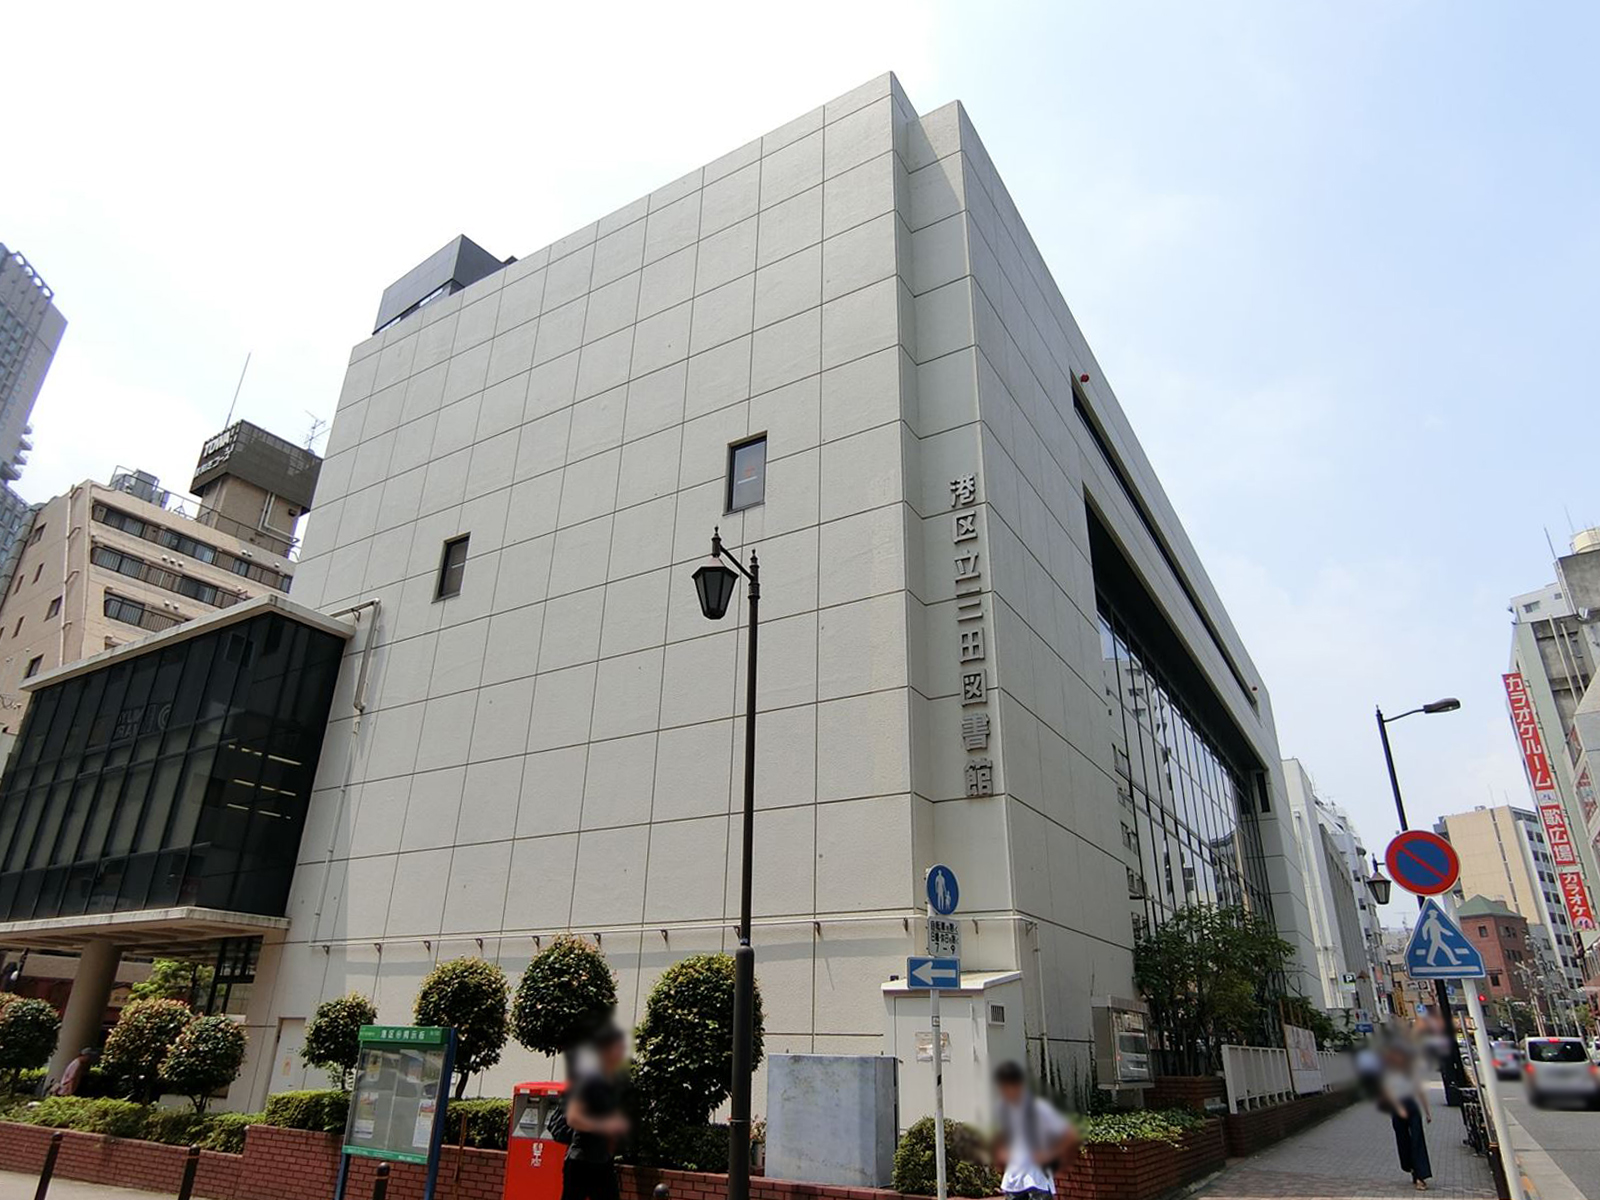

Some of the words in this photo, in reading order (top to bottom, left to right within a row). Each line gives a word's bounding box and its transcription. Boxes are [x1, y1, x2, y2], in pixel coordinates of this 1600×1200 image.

[949, 472, 994, 798] 港区立三田図書館
[1505, 675, 1553, 788] カラオケルーム
[1541, 808, 1574, 863] 歌広場
[1563, 873, 1588, 917] カラオケ
